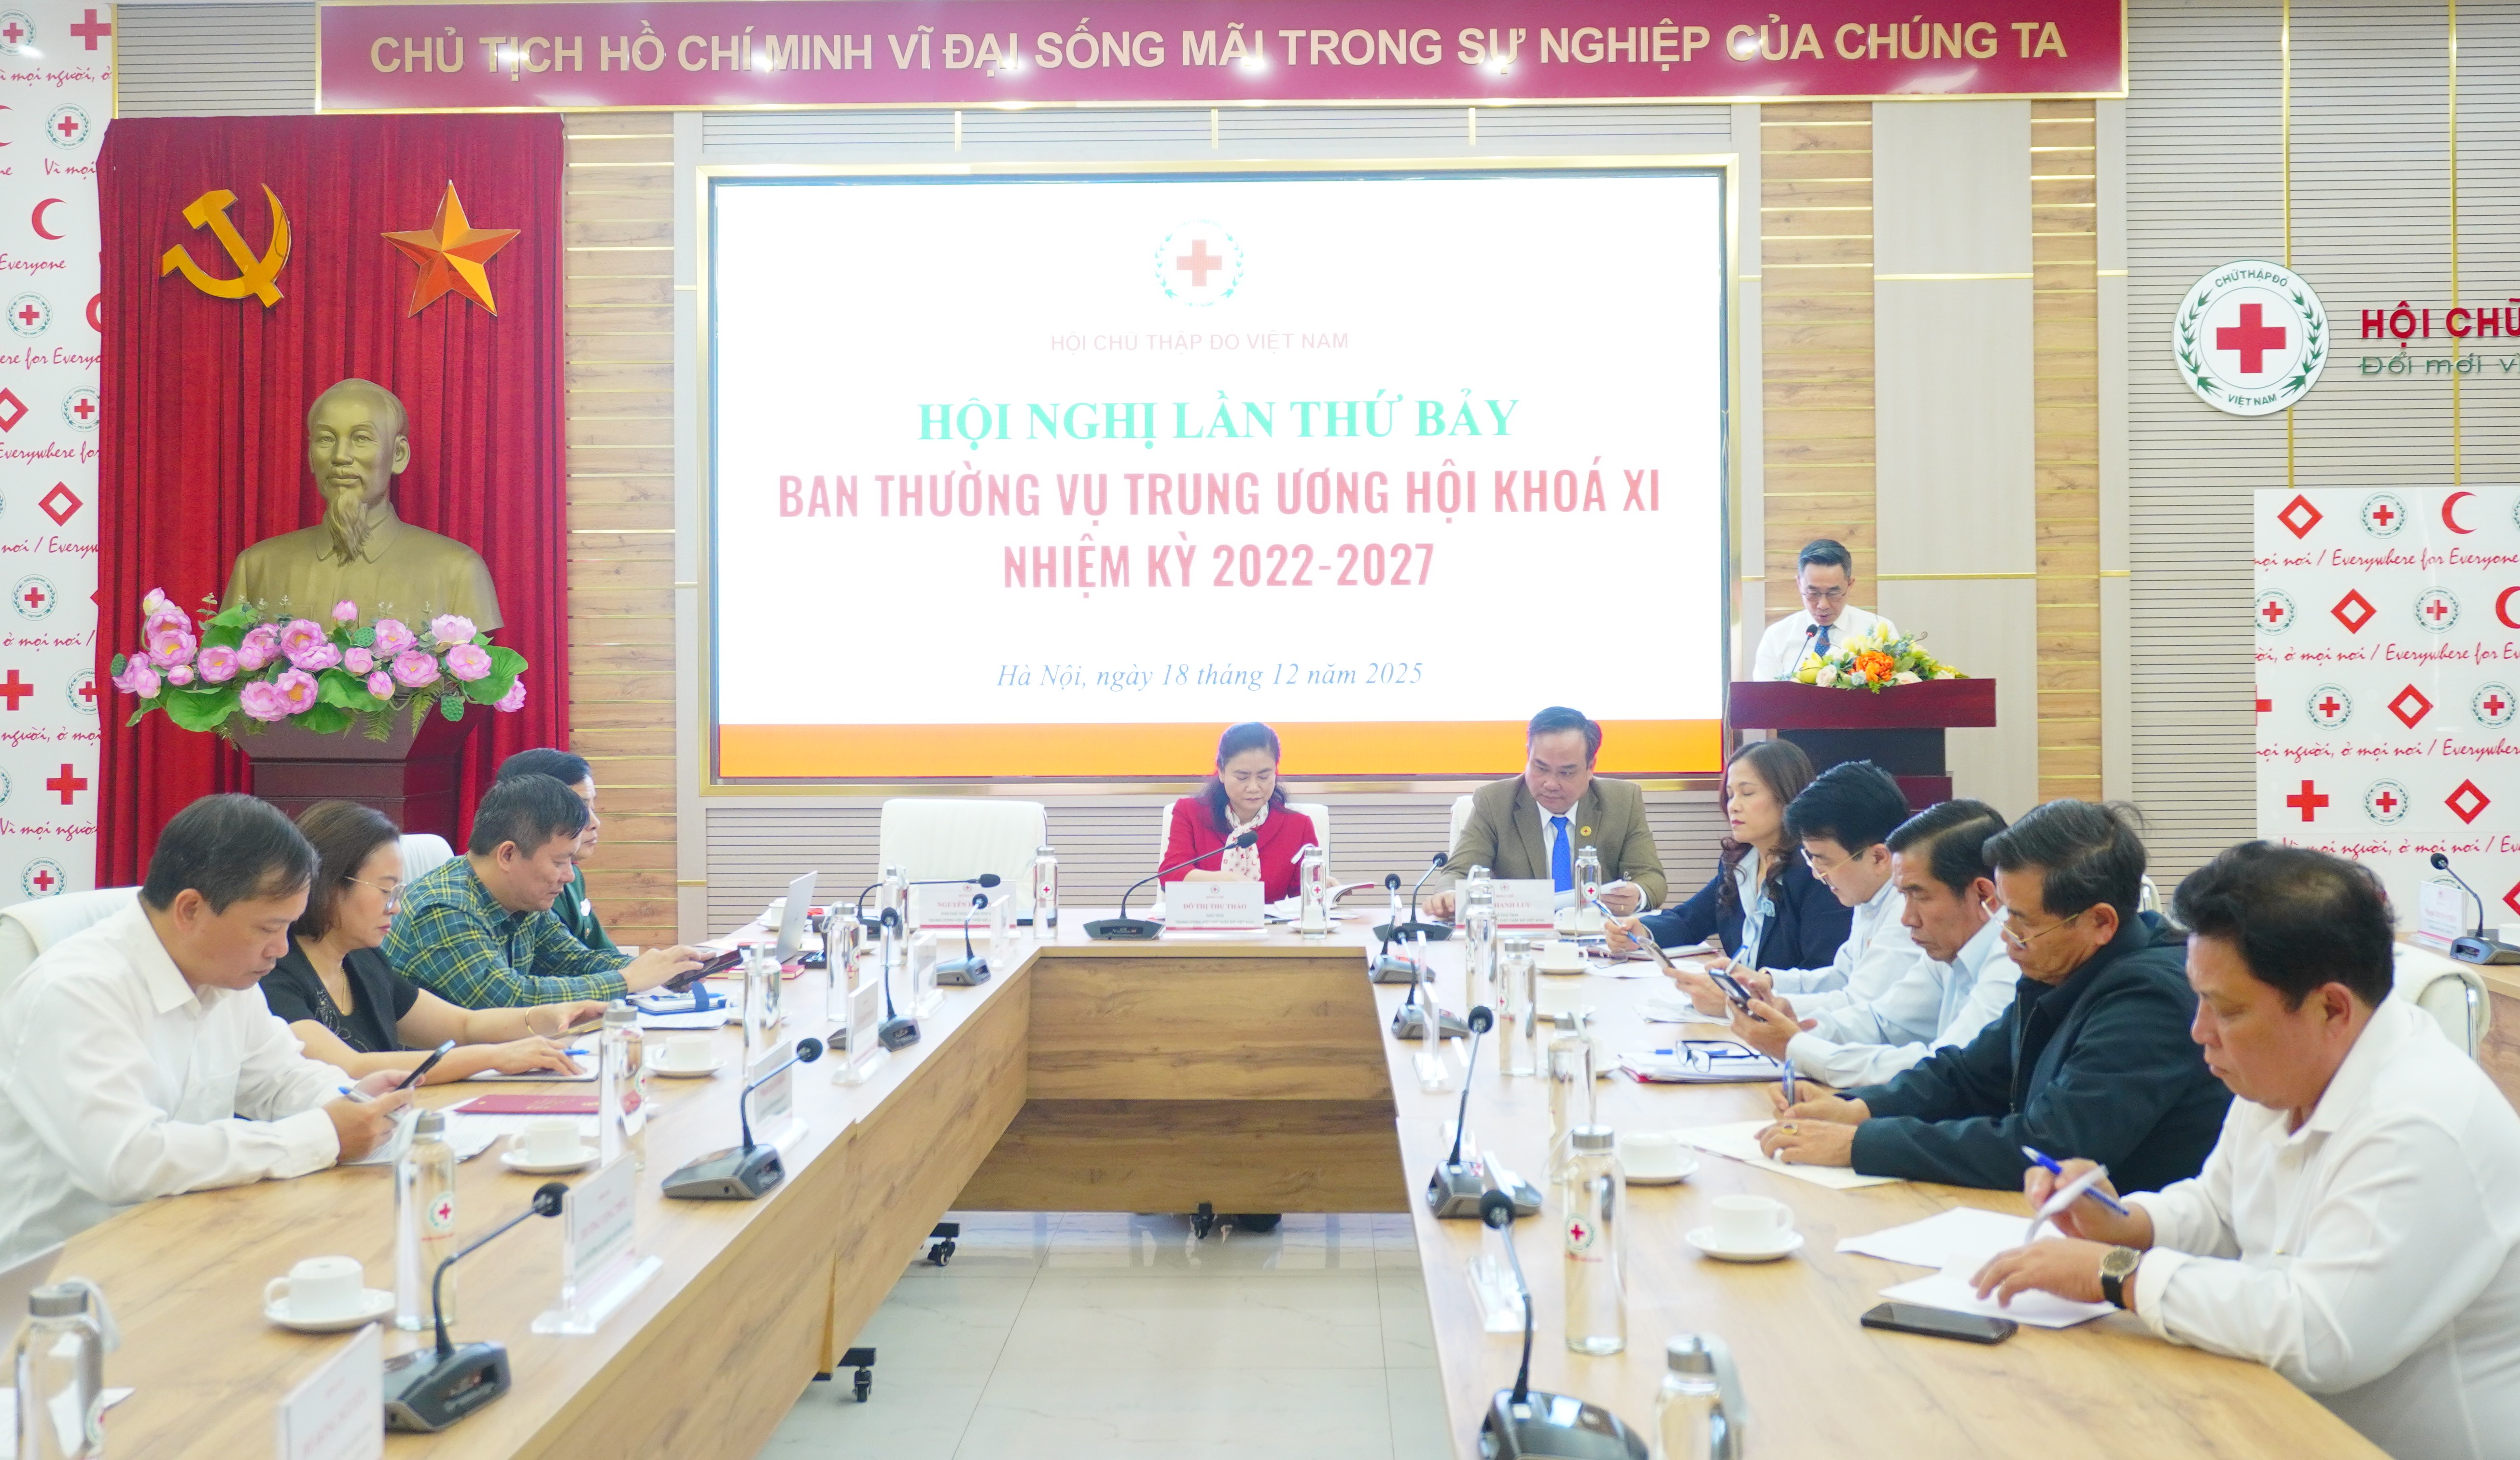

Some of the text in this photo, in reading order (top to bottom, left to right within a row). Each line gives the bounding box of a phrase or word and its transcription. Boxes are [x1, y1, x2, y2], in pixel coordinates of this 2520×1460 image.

[371, 14, 2068, 82] CHỦ TỊCH HỒ CHÍ MINH VĨ ĐẠI SỐNG MÃI TRONG SỰ NGHIỆP CỦA CHÚNG TA
[45, 158, 60, 175] Vì
[2362, 301, 2429, 348] HỘI
[1051, 332, 1086, 355] HỘI
[1146, 331, 1202, 354] THẬP
[1247, 330, 1294, 353] VIỆT
[1302, 333, 1348, 349] NAM
[26, 347, 48, 370] for
[53, 347, 101, 370] Everyo
[2360, 351, 2412, 374] Đổi
[2426, 353, 2480, 373] mới
[917, 388, 1520, 450] HỘI NGHỊ LẦN THỨ BẢY
[779, 456, 1660, 526] BAN THƯỜNG VỤ TRUNG ƯƠNG HỘI KHOÁ XI
[1005, 531, 1435, 598] NHIỆM KỲ 2022-2027
[2332, 548, 2415, 571] Everywhere
[2421, 547, 2444, 570] for
[2450, 547, 2520, 570] Everyone
[2386, 642, 2470, 667] Everywhere
[2474, 642, 2498, 665] for
[995, 662, 1423, 692] Hà Nội, ngày 18 tháng 12 năm 2025
[2443, 738, 2520, 762] Everywher
